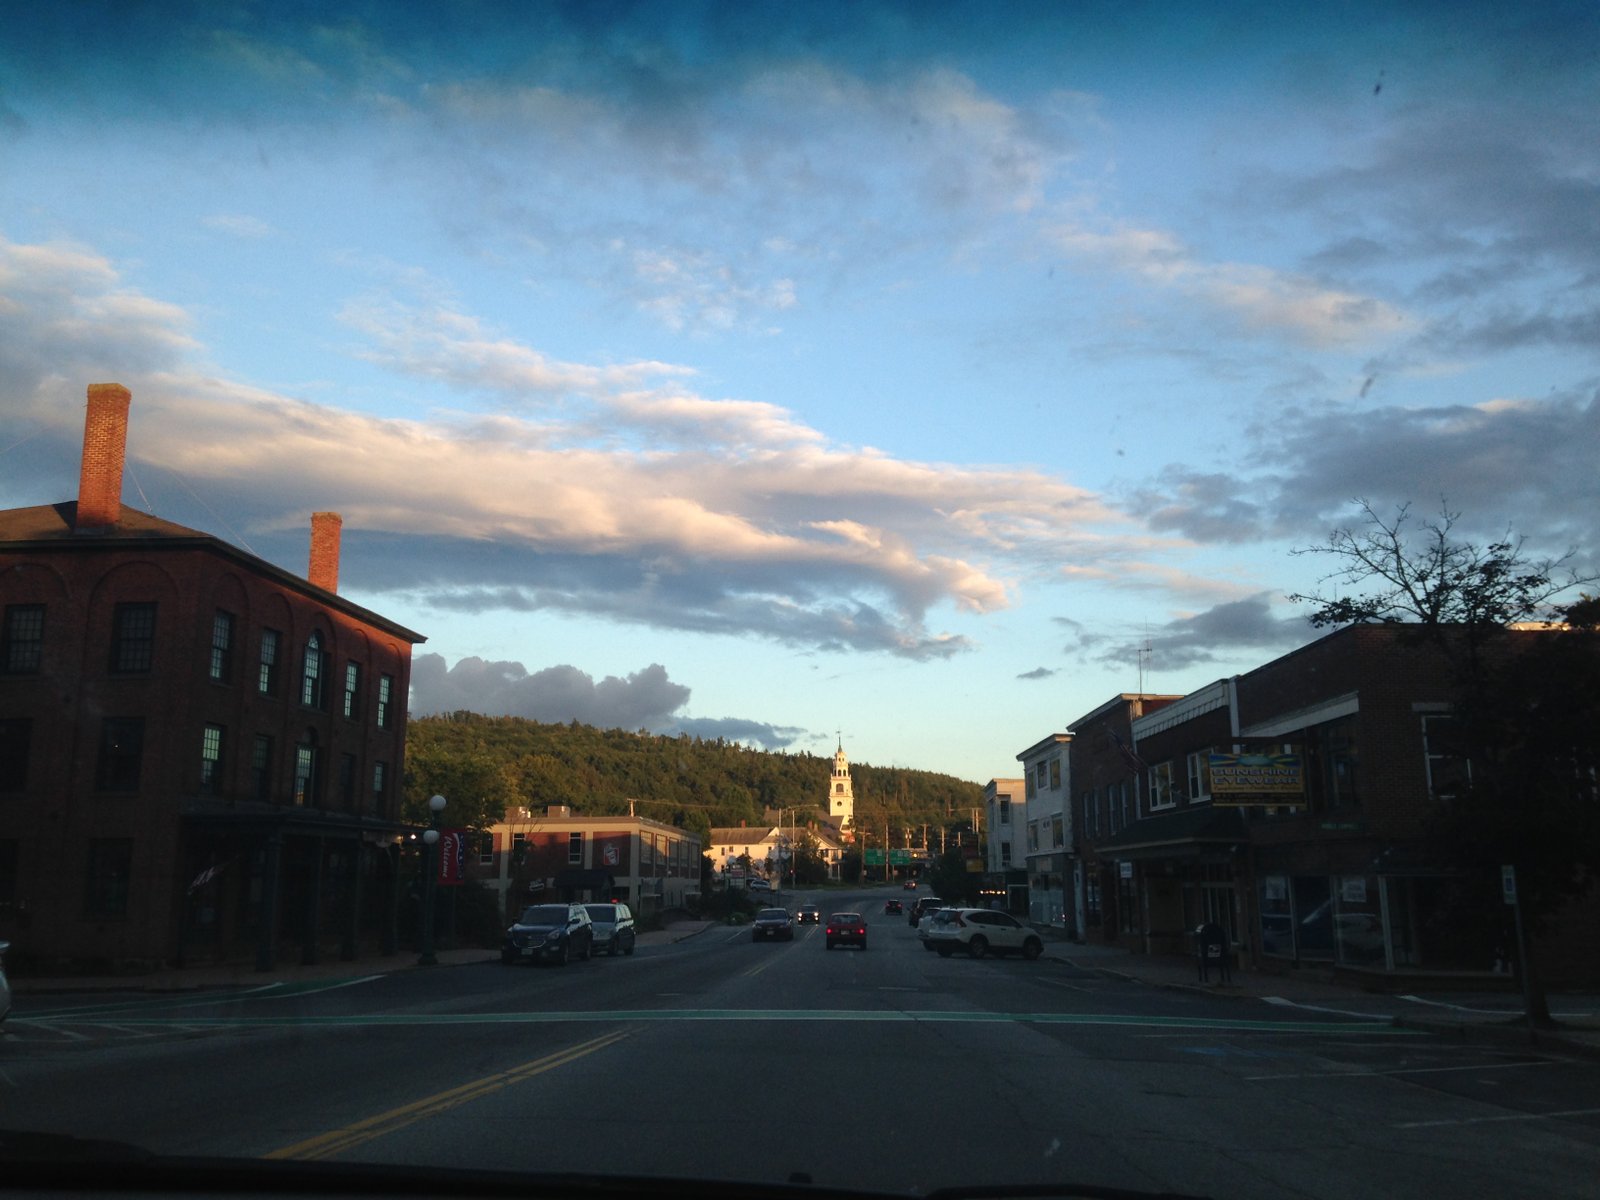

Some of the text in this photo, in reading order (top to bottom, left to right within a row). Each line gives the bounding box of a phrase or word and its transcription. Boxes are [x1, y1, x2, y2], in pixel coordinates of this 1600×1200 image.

[1212, 768, 1298, 776] SUNSHINE
[1214, 776, 1298, 785] EYEWEAR
[442, 836, 453, 880] Welcome
